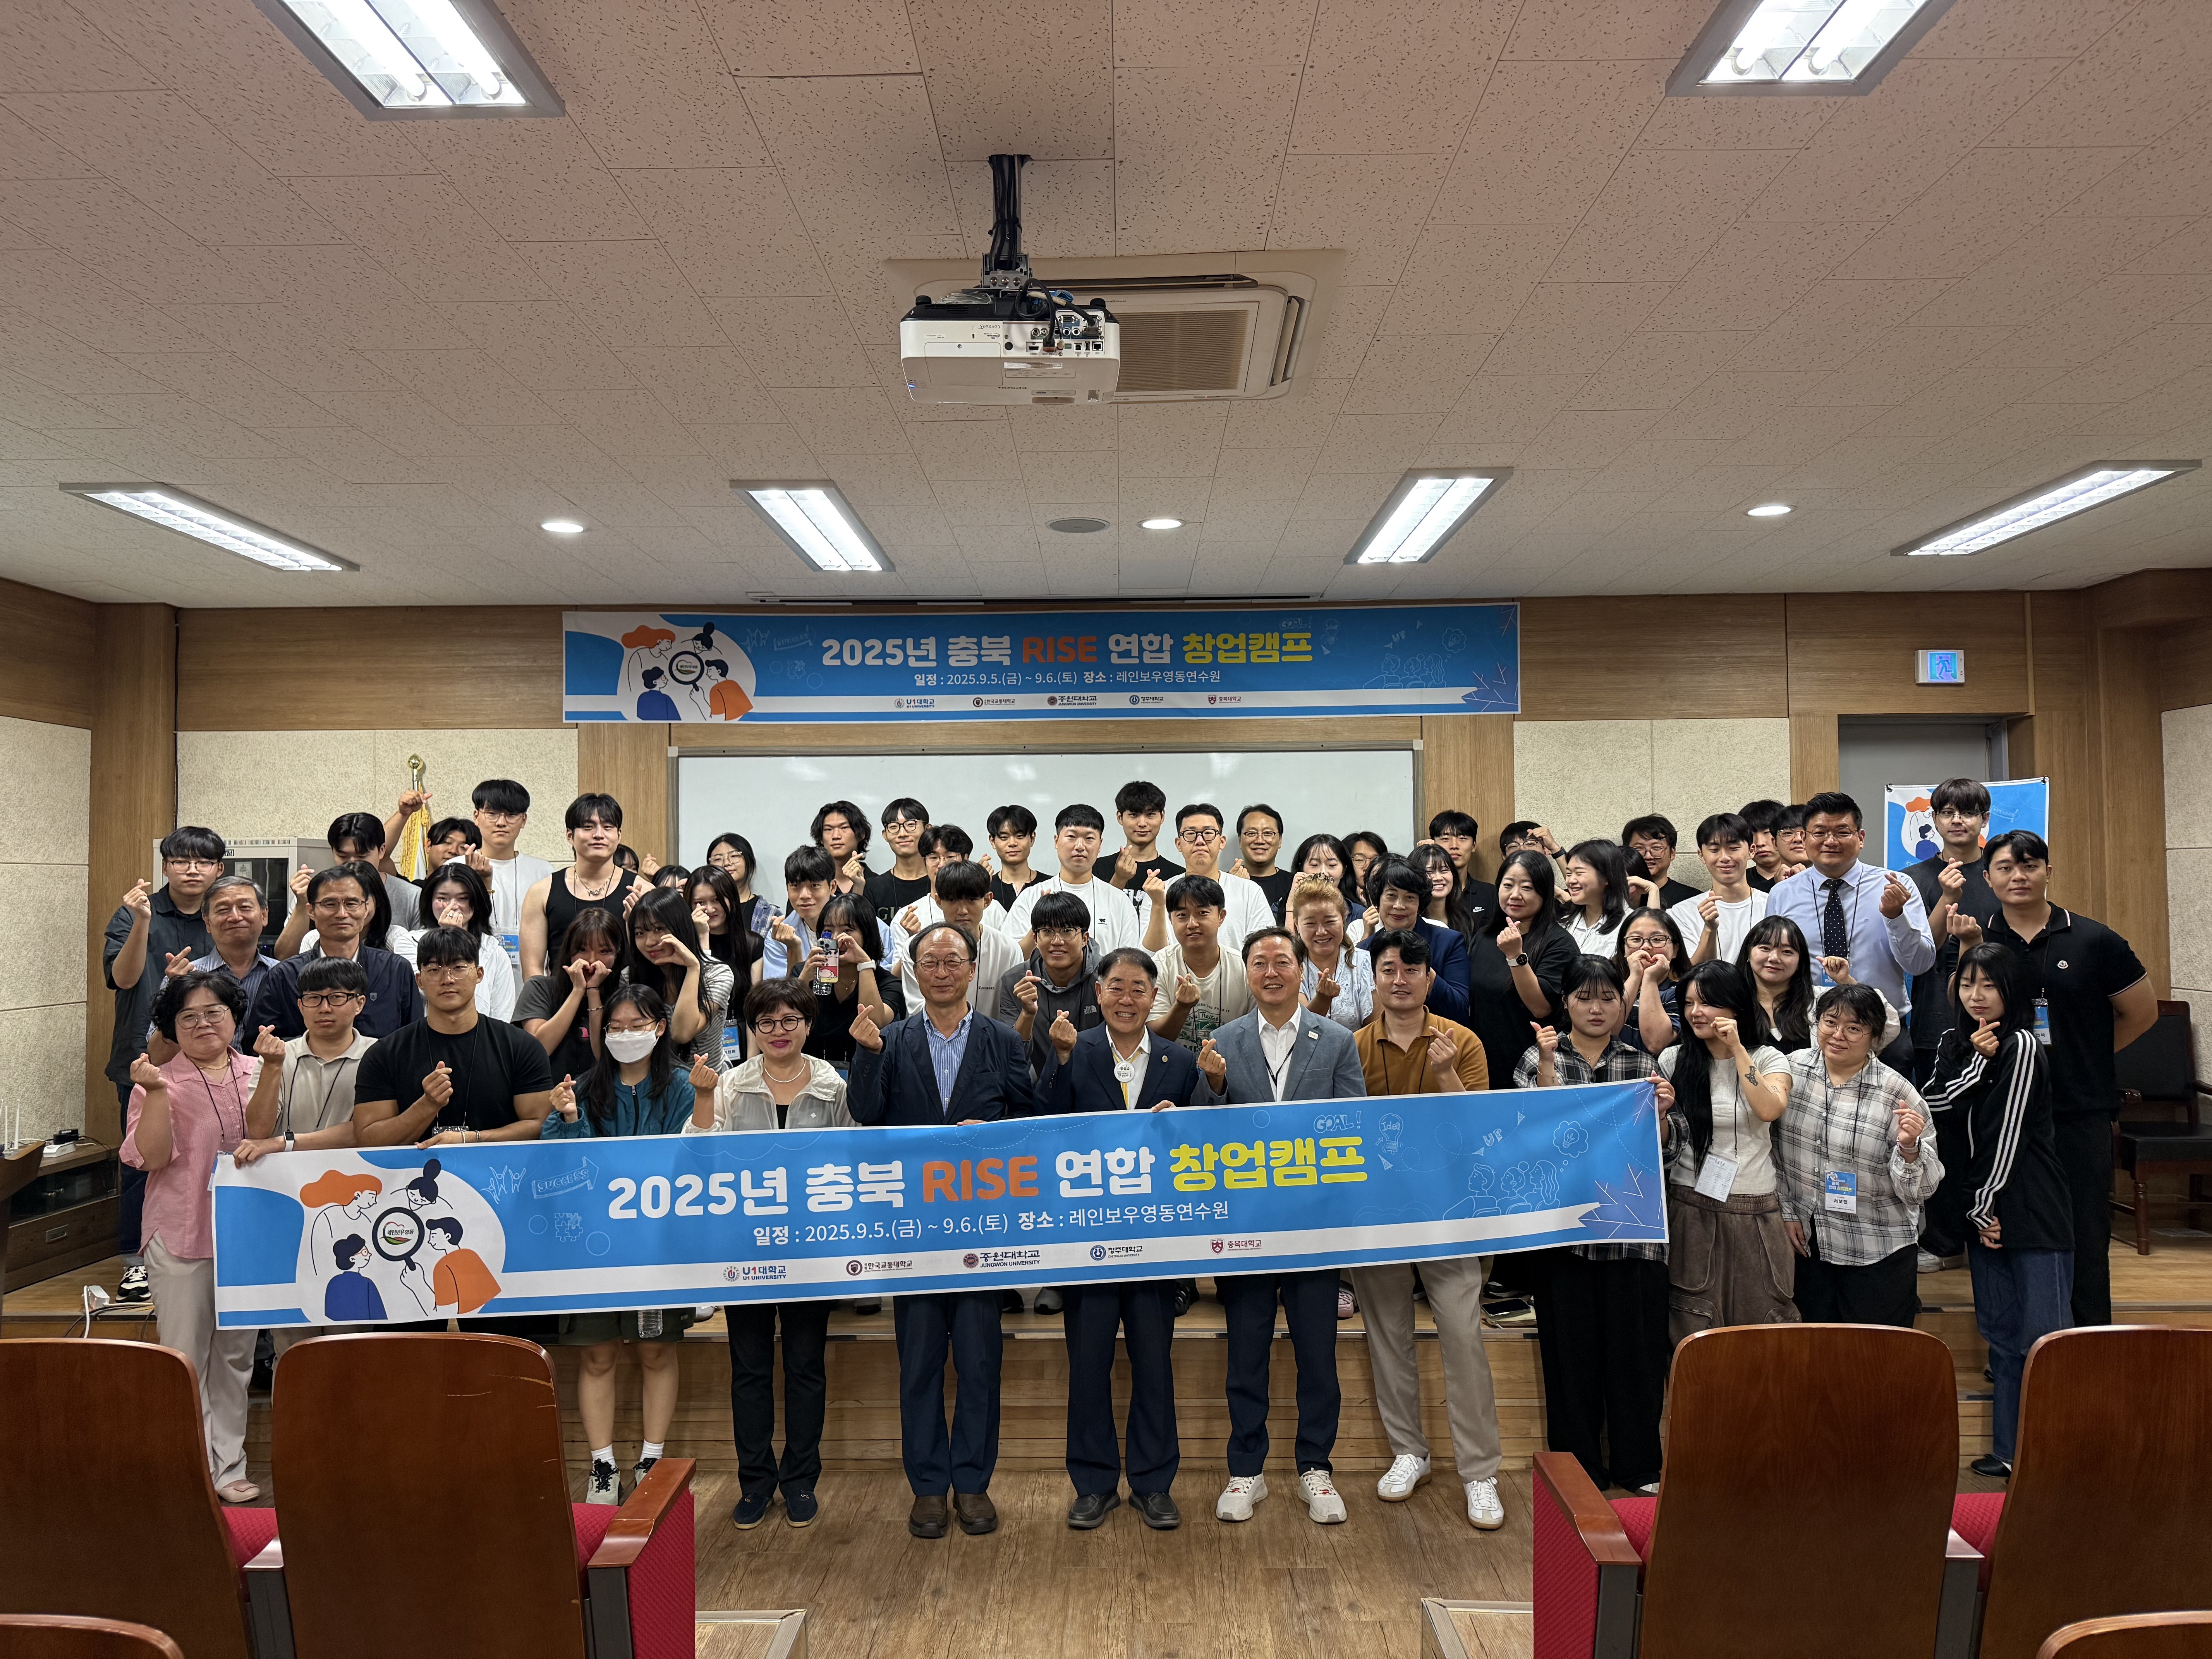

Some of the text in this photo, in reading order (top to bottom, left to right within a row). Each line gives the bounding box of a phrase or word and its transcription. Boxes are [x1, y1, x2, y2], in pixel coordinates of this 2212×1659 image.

[823, 632, 1313, 667] 2025년 충북 RISE 연합 창업캠프
[915, 674, 937, 686] 일정
[947, 673, 1022, 686] 2025.9.5.(금)
[1036, 672, 1077, 685] 9.6.(토)
[1084, 672, 1107, 684] 장소
[1117, 671, 1220, 683] 레인보우영동연수원
[1314, 1111, 1361, 1133] GOAL!
[1381, 1121, 1400, 1132] Idea
[1482, 1128, 1503, 1146] UP
[538, 1169, 589, 1192] SUCCESS
[608, 1136, 1368, 1219] 2025년 충북 RISE 연합 창업캠프
[753, 1226, 788, 1246] 일정
[805, 1219, 921, 1242] 2025.9.5.(금)
[943, 1213, 1008, 1235] 9.6.(토)
[1018, 1211, 1054, 1230] 장소
[1069, 1201, 1228, 1227] 레인보우영동연수원
[1108, 1246, 1143, 1254] 청주대학교
[1228, 1240, 1262, 1248] 충북대학교
[980, 1250, 1040, 1262] 중원대학교
[742, 1266, 786, 1275] U1대학교
[868, 1260, 912, 1269] 한국교통대학교
